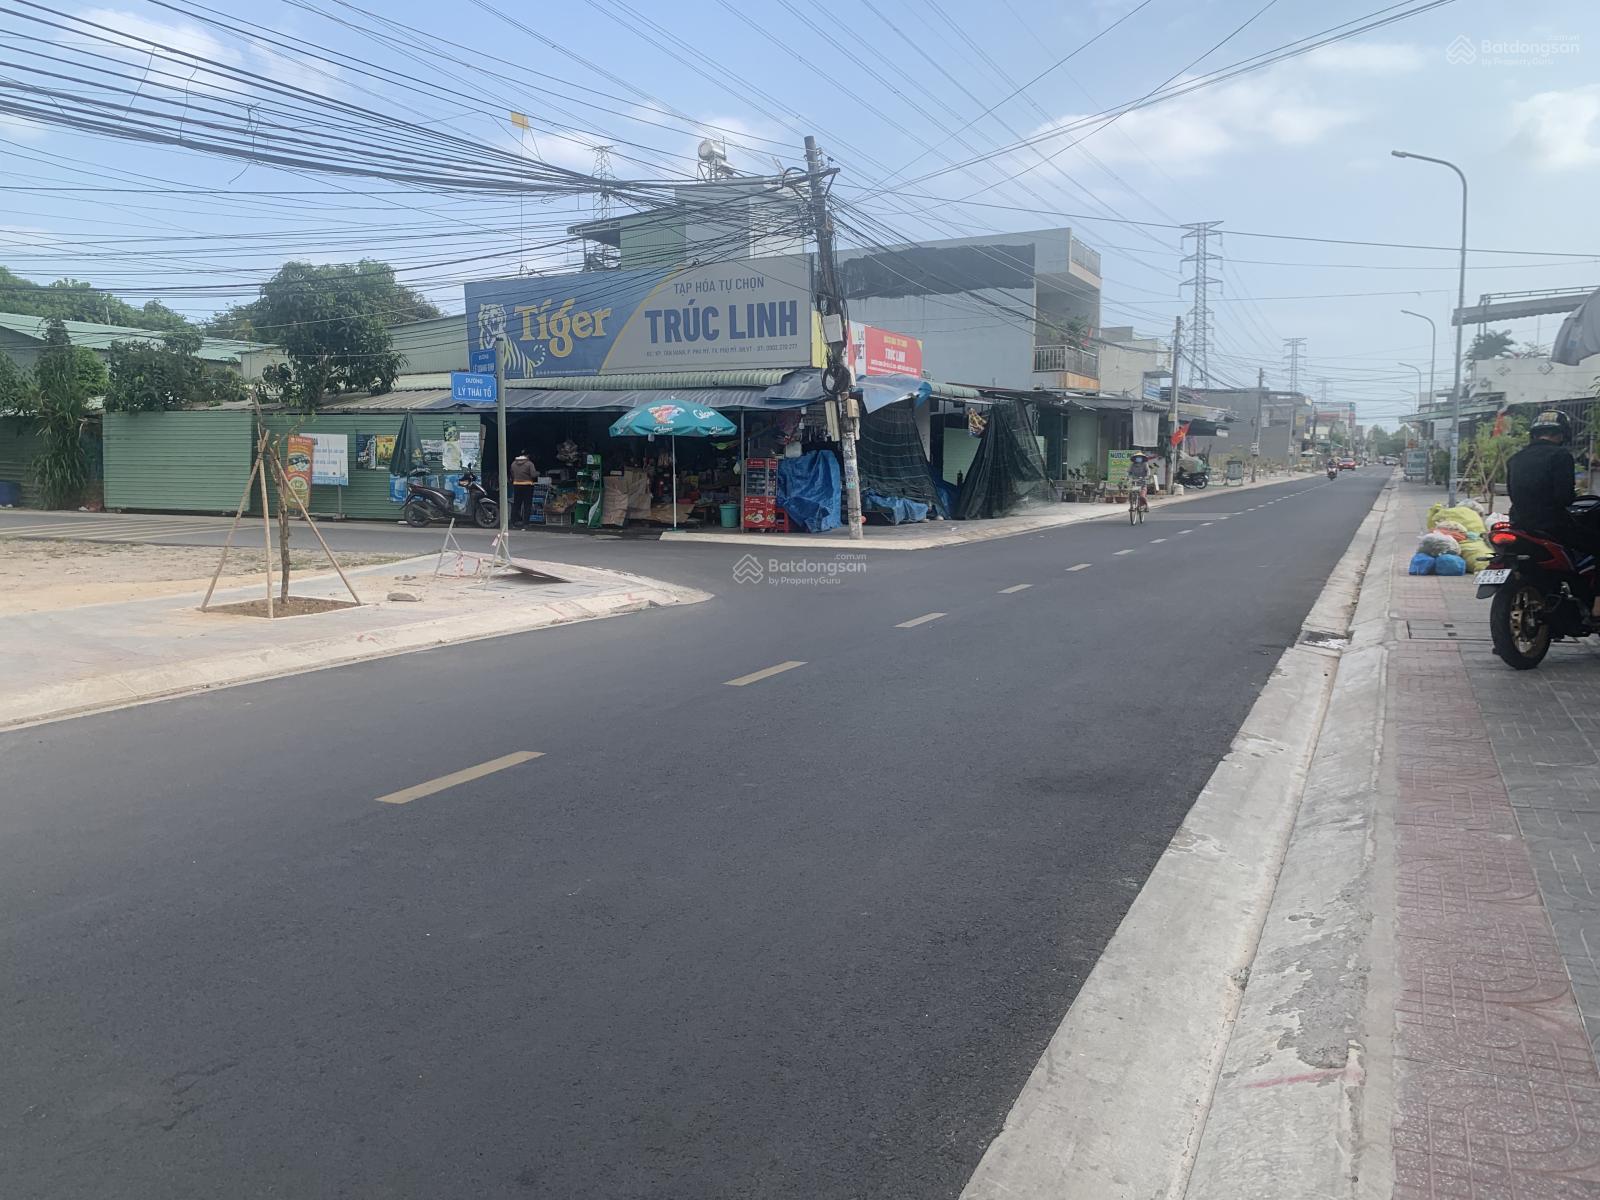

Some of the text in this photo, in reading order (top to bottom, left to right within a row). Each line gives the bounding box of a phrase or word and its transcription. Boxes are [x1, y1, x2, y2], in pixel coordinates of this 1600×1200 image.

[673, 276, 765, 297] TẠP HÓA TỰ CHỌN
[514, 298, 612, 358] Tiger
[644, 298, 798, 344] TRÚC LINH
[458, 385, 492, 398] LÝ THÁI TỔ
